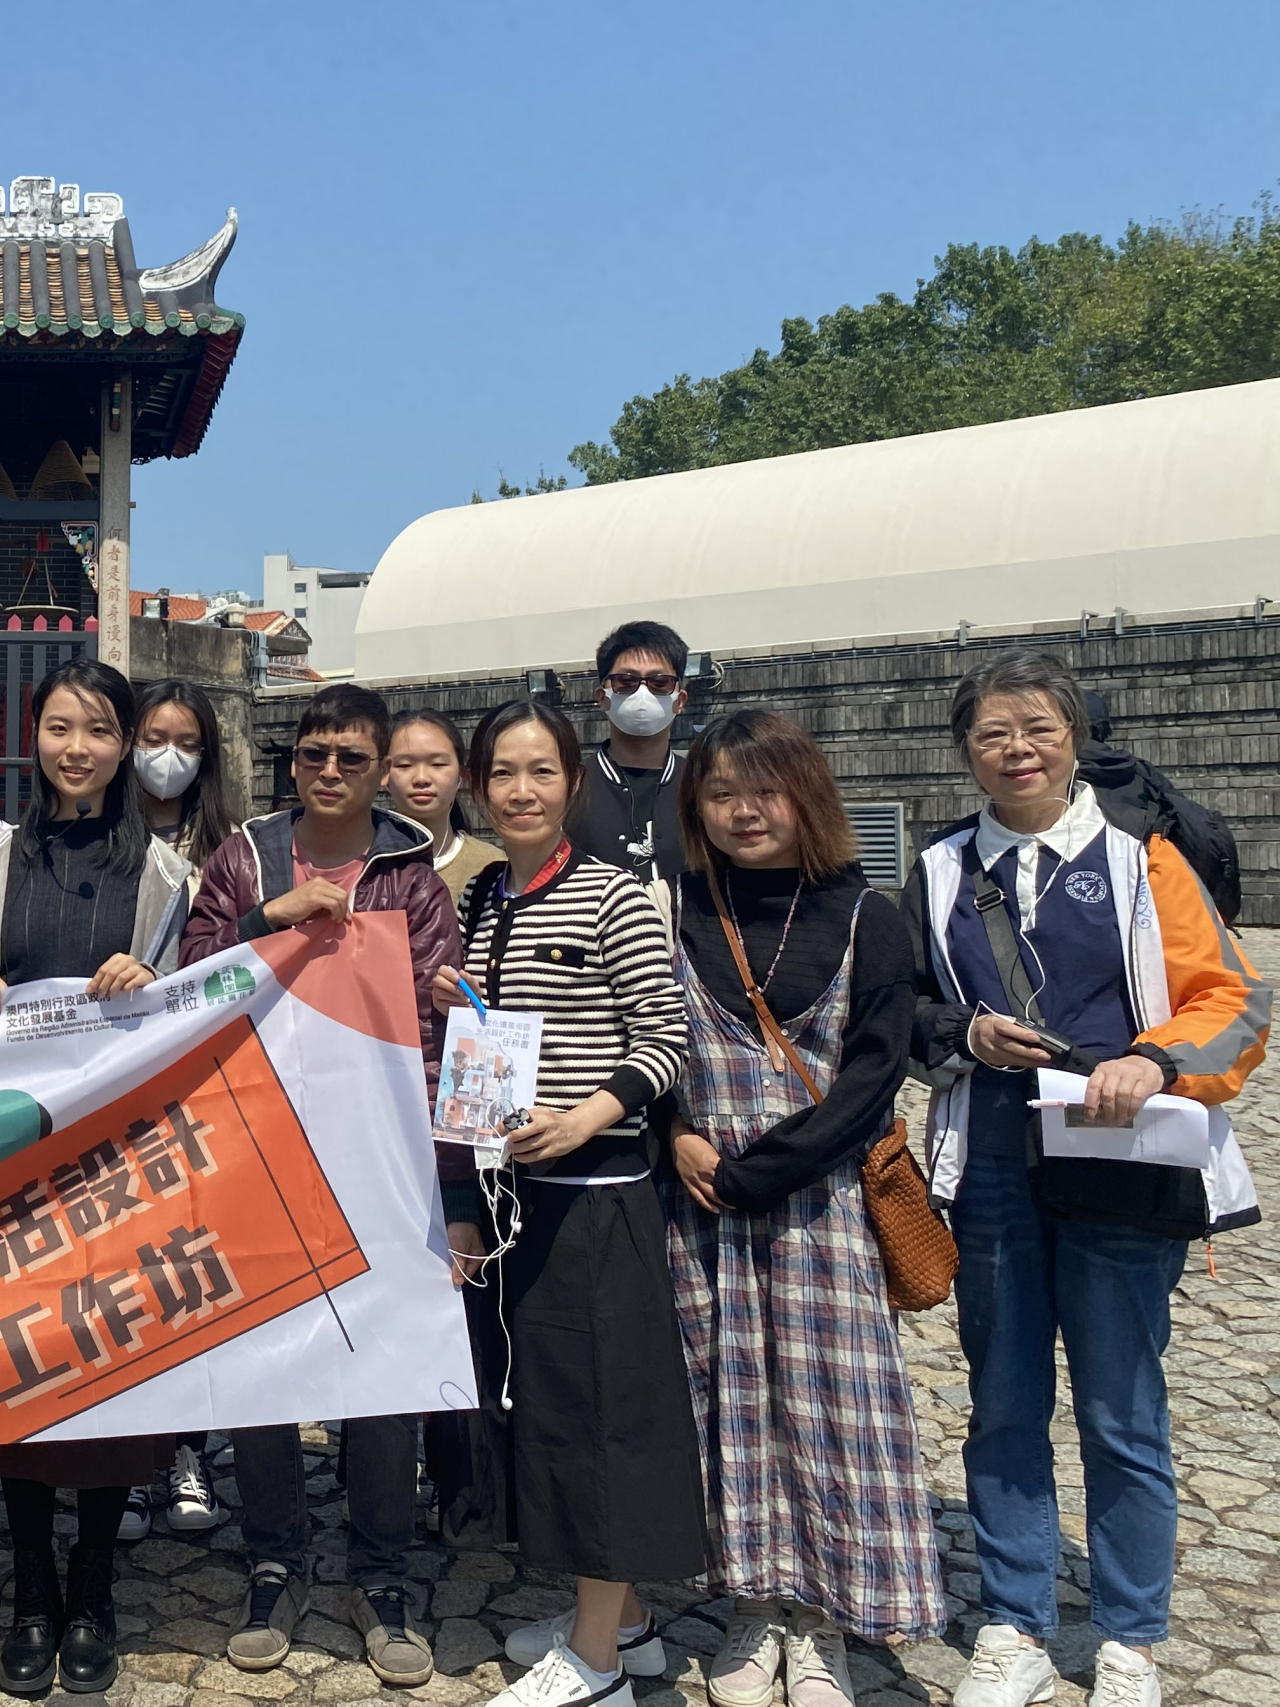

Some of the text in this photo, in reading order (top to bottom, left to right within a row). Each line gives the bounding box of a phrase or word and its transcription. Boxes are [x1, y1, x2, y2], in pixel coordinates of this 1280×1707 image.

[1081, 873, 1100, 882] YORK
[164, 980, 196, 1000] 支持
[166, 996, 200, 1015] 單位
[6, 1008, 77, 1029] 文化發展基金
[40, 1024, 60, 1032] Região
[100, 1014, 122, 1023] Especial
